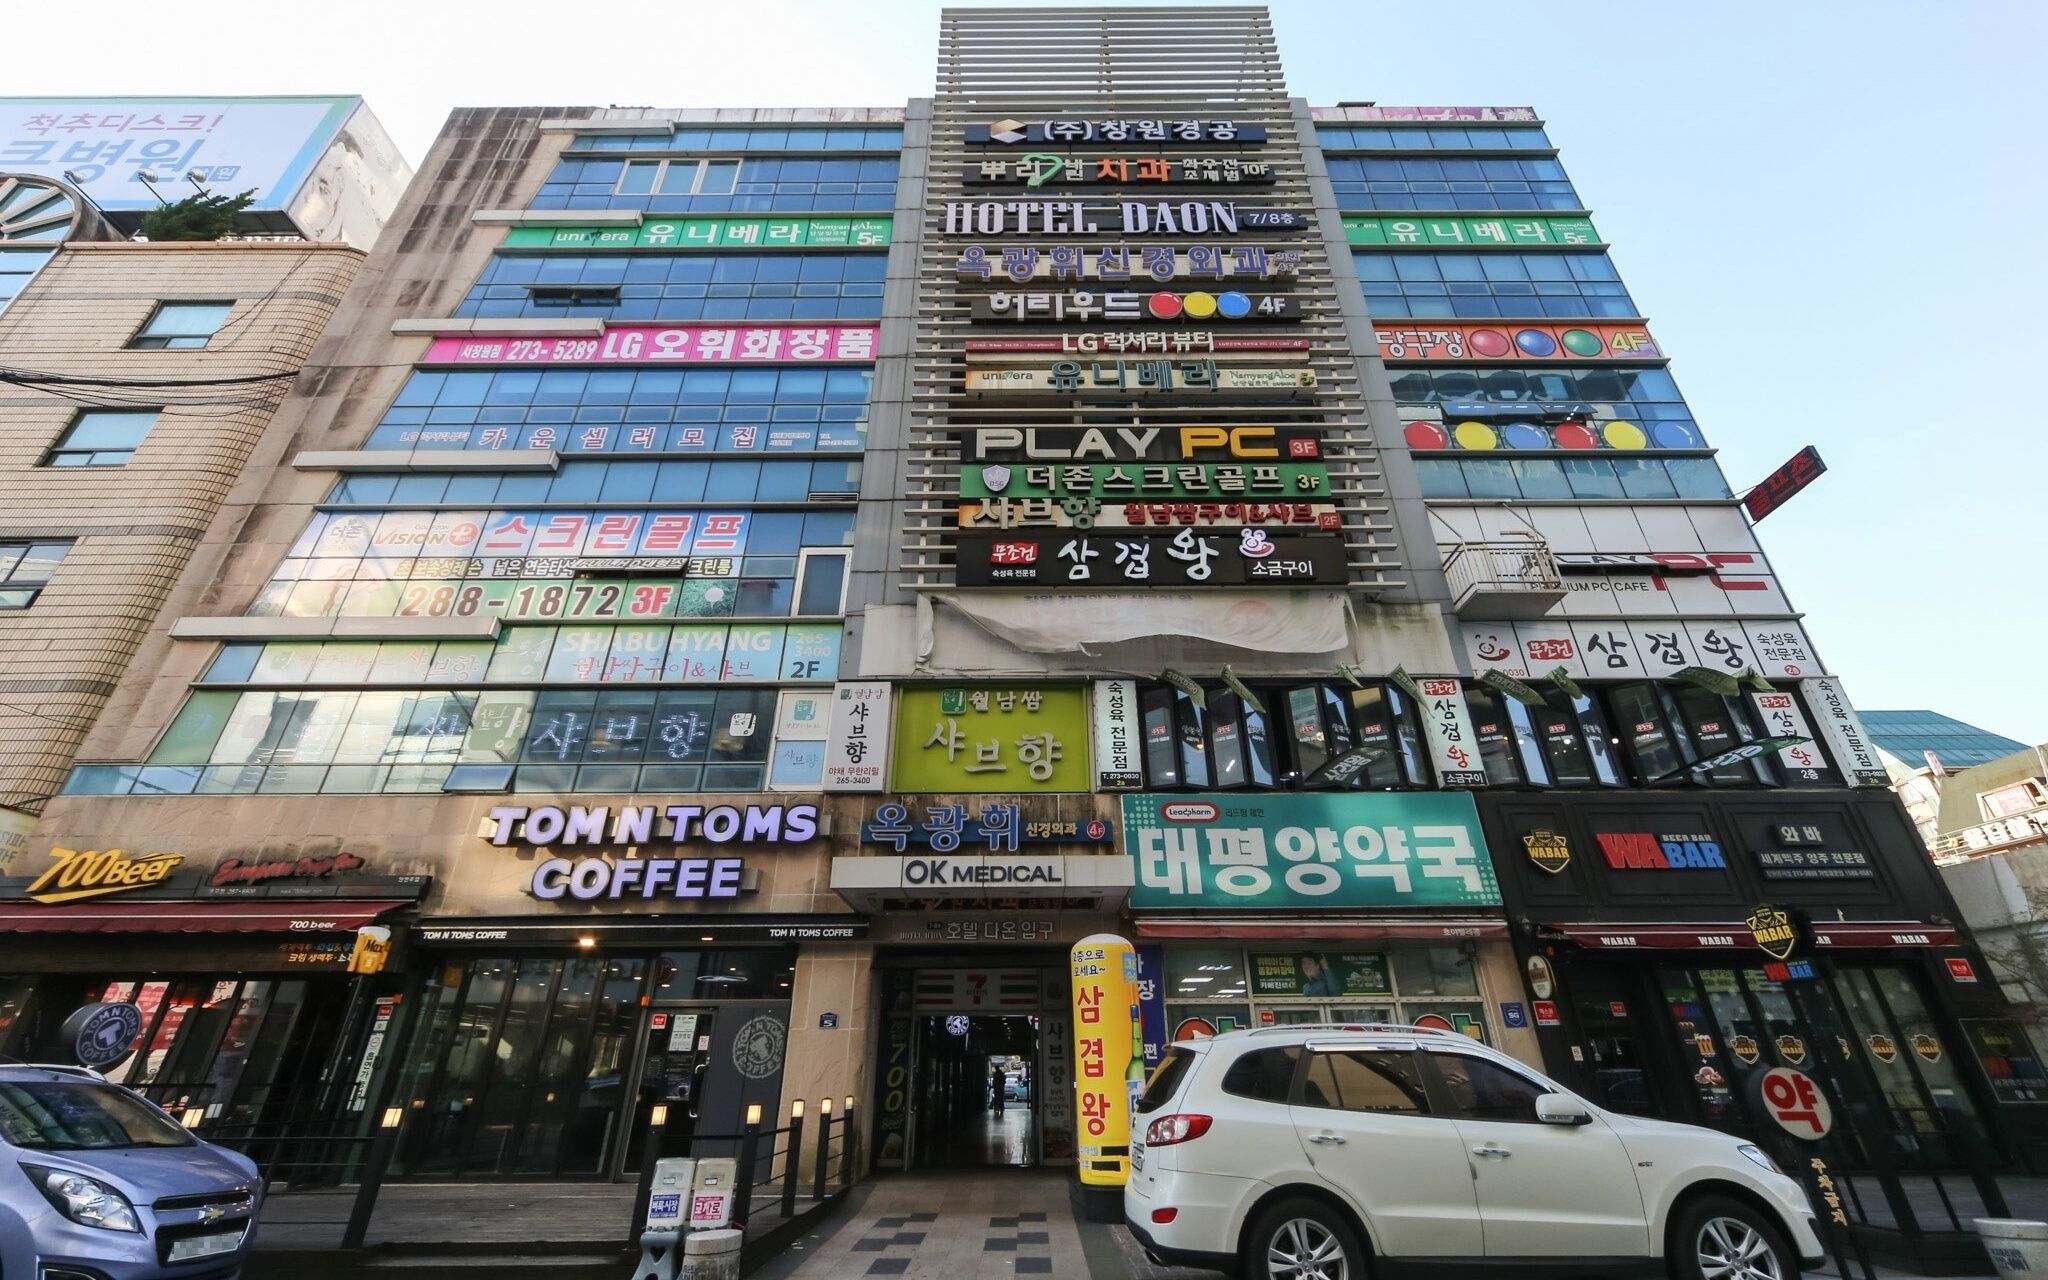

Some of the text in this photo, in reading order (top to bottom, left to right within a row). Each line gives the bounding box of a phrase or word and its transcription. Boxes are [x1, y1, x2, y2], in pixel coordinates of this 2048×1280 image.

[22, 112, 224, 135] 척추디스크!
[1044, 119, 1238, 141] (주)창원경공
[980, 160, 1041, 181] 뿌리
[1096, 158, 1171, 182] 치과
[1241, 164, 1270, 175] 10F
[945, 201, 1295, 235] HOTEL DAON 7/8층
[643, 222, 802, 245] 유니베라
[857, 231, 884, 246] 5F
[1390, 221, 1547, 243] 유니베라
[956, 245, 1270, 283] 옥광휘신경외과
[989, 290, 1286, 321] 허리우드 4F
[602, 332, 643, 359] LG
[649, 328, 873, 360] 오휘화장품
[1062, 332, 1099, 354] LG
[1375, 330, 1650, 358] 당구장 4F
[1046, 359, 1221, 393] 유니베라
[975, 426, 1315, 460] PLAY PC 3F
[1025, 465, 1285, 492] 더존스크린골프
[1297, 474, 1320, 490] 3F
[972, 497, 1102, 530] 샤브향
[1323, 515, 1337, 526] 2F
[484, 514, 744, 550] 스크린골프
[1057, 526, 1220, 581] 삼겹왕
[1252, 560, 1314, 577] 소금구이
[1014, 569, 1036, 578] 전문점
[1591, 582, 1611, 592] PC
[1614, 582, 1650, 592] CAFE
[400, 585, 672, 617] 288-1872 3F
[563, 631, 772, 653] SHABUHYANG
[1587, 629, 1744, 669] 삼겹왕
[1756, 632, 1798, 646] 숙성육
[1764, 648, 1807, 662] 전문점
[789, 660, 821, 679] 2F
[532, 711, 706, 760] 샤브향
[845, 701, 870, 765] 샤브향
[1434, 698, 1470, 769] 삼겹왕
[922, 718, 1064, 782] 샤브향
[836, 776, 871, 785] 265-3400
[847, 766, 880, 777] 무한리필
[1447, 772, 1484, 785] 소금구이
[488, 803, 819, 846] TOM N TOMS
[868, 802, 1020, 852] 옥광휘
[1025, 821, 1078, 840] 신경외과
[1137, 824, 1484, 897] 태평양약국
[1528, 847, 1570, 858] WABAR
[1831, 852, 1866, 864] 전문점
[530, 856, 745, 901] COFFEE
[905, 859, 1062, 885] OK MEDICAL
[289, 920, 337, 930] 700 beer
[422, 930, 508, 940] TOM N TOMS COFFEE
[769, 929, 854, 938] TOM N TOMS COFFEE
[945, 921, 1054, 941] 호텔 다온 입구
[1752, 925, 1795, 944] WABAR
[363, 939, 385, 953] Max
[1600, 936, 1638, 946] WABAR
[1697, 936, 1735, 946] WABAR
[1891, 934, 1931, 945] WABAR
[86, 1009, 110, 1037] TOM
[111, 1006, 121, 1017] N
[81, 1039, 127, 1061] COFFEE
[1077, 985, 1111, 1137] 삼겹왕
[1763, 1073, 1825, 1133] 약
